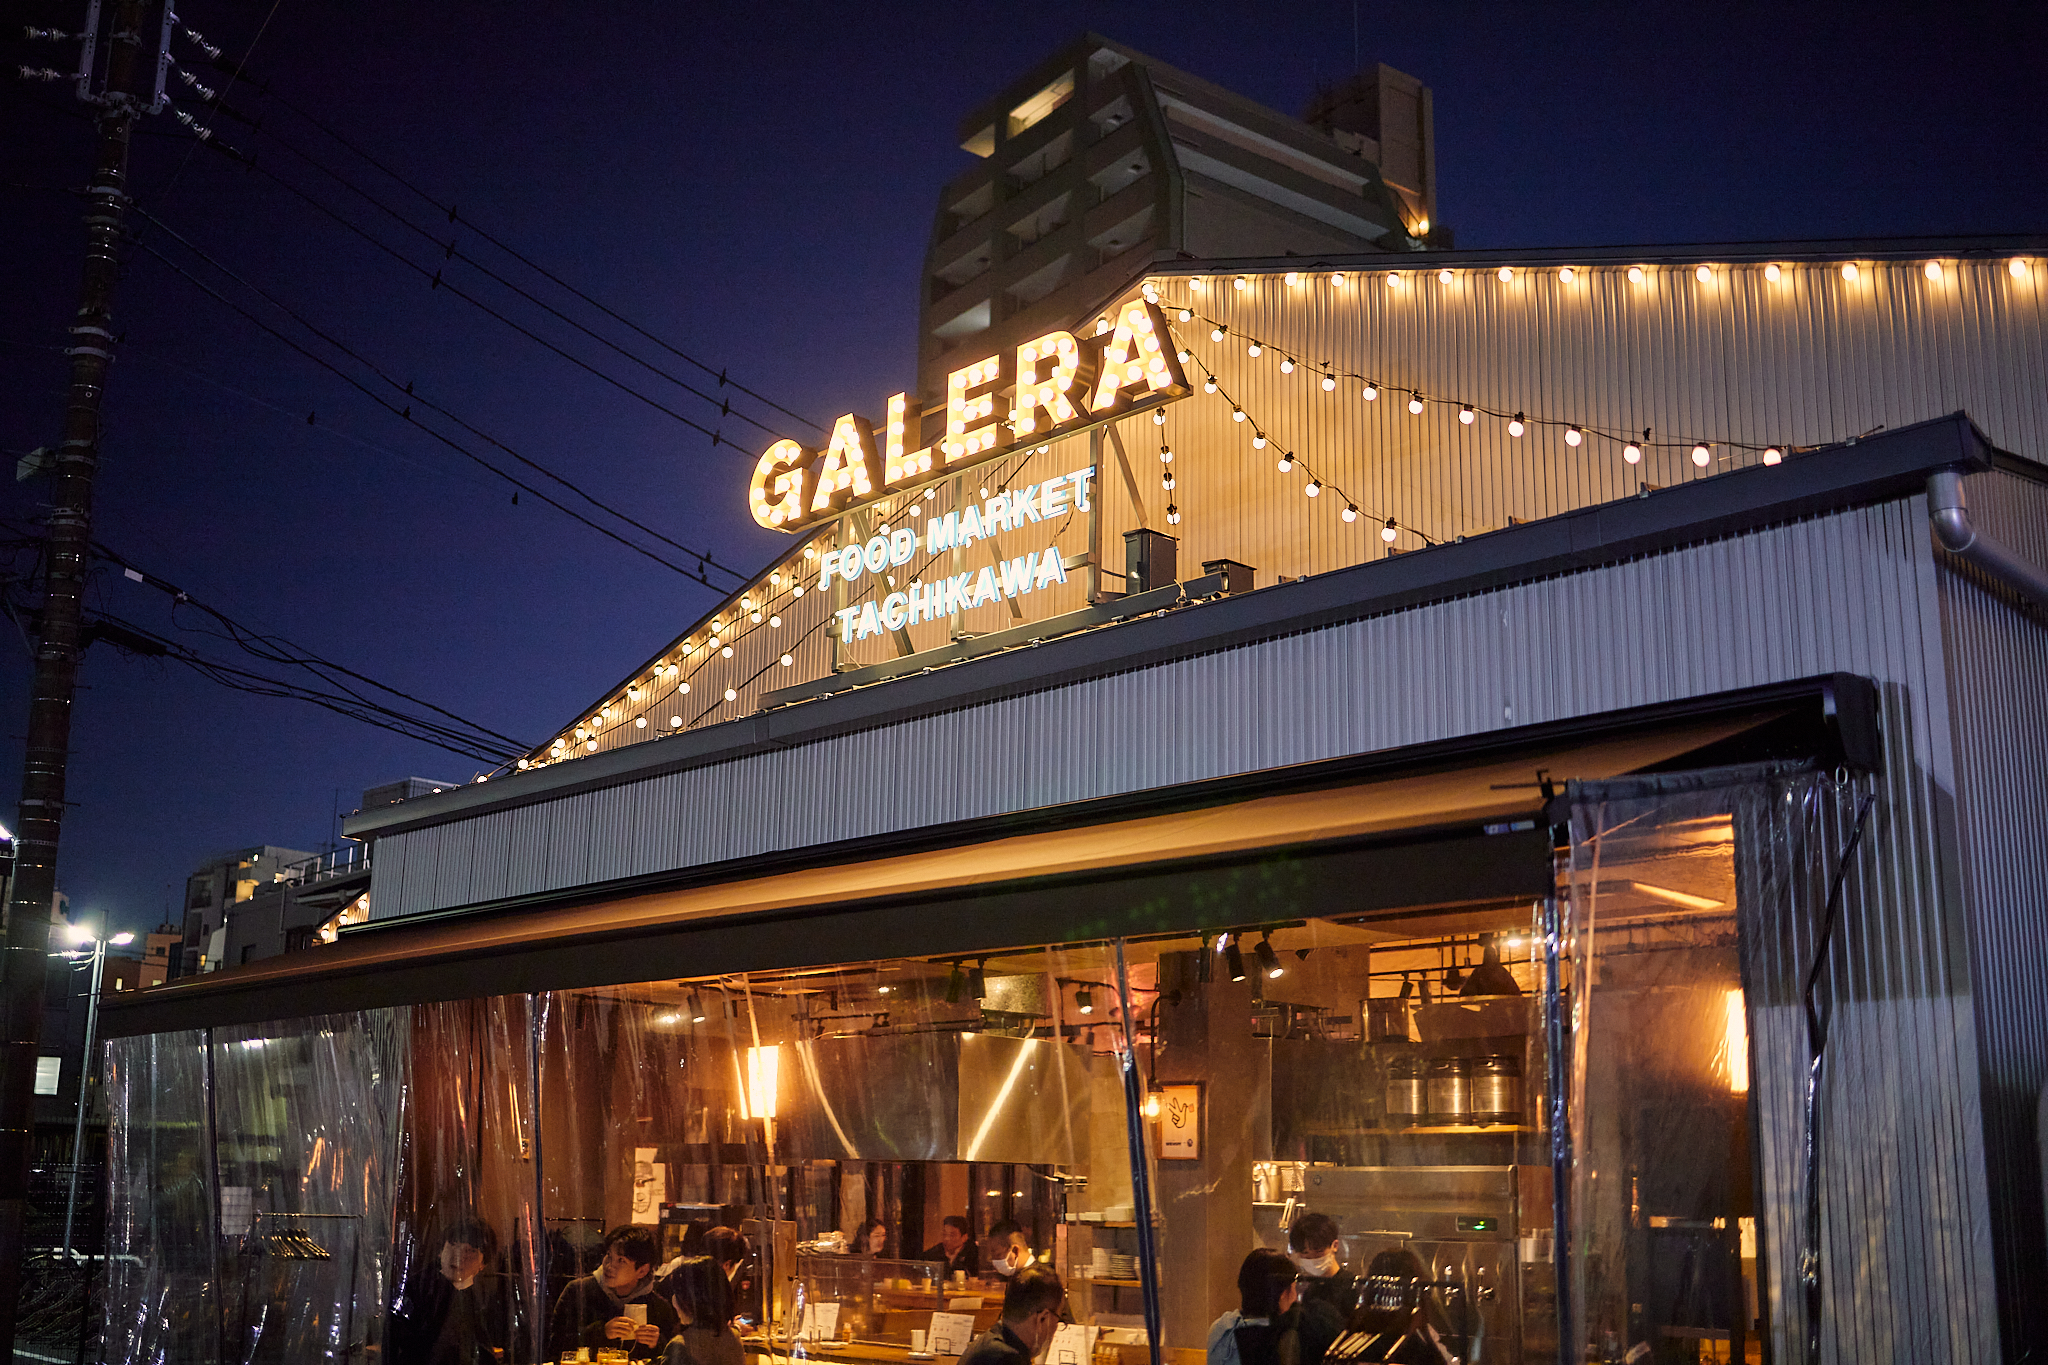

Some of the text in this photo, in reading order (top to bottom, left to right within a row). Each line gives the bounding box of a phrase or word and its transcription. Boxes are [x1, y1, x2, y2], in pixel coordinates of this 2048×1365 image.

[749, 297, 1190, 531] GALERA
[820, 466, 1096, 587] FOOD MARKET
[836, 547, 1067, 644] TACHIKAWA
